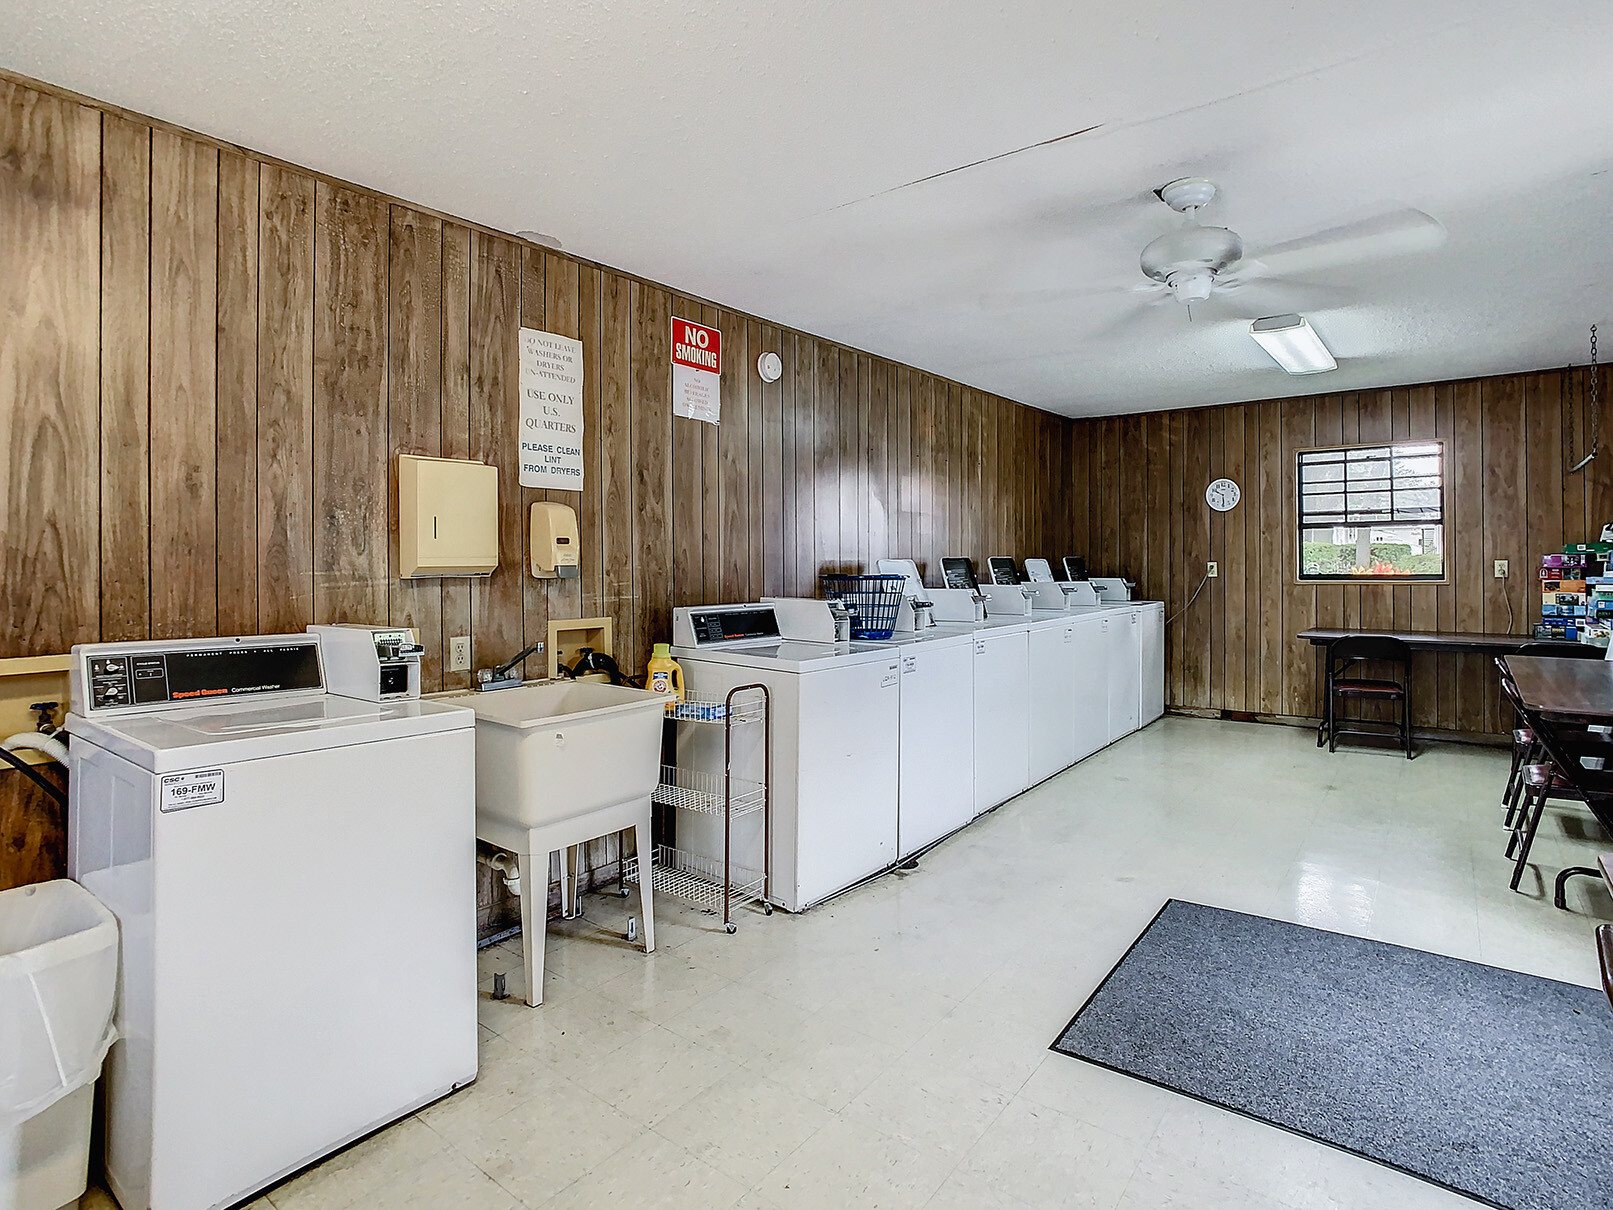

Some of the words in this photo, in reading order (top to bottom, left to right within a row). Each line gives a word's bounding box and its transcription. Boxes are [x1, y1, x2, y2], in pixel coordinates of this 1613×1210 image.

[537, 339, 552, 349] NOT
[685, 325, 709, 349] NO
[527, 347, 561, 360] WASHERS
[562, 355, 573, 363] OR
[675, 342, 717, 369] SMOKING
[536, 360, 565, 371] DRYERS
[527, 388, 546, 400] USE
[548, 392, 575, 405] ONLY
[543, 405, 560, 416] U.S.
[525, 417, 577, 434] QUARTERS
[522, 442, 553, 453] PLEASE
[556, 446, 580, 456] CLEAN
[544, 455, 561, 464] LINT
[523, 464, 547, 473] FROM
[551, 466, 581, 477] DRYERS
[172, 689, 200, 699] Speed
[201, 687, 228, 696] Queen
[231, 684, 261, 693] Commercial
[163, 776, 180, 784] CSC
[170, 782, 216, 796] 169-FMW
